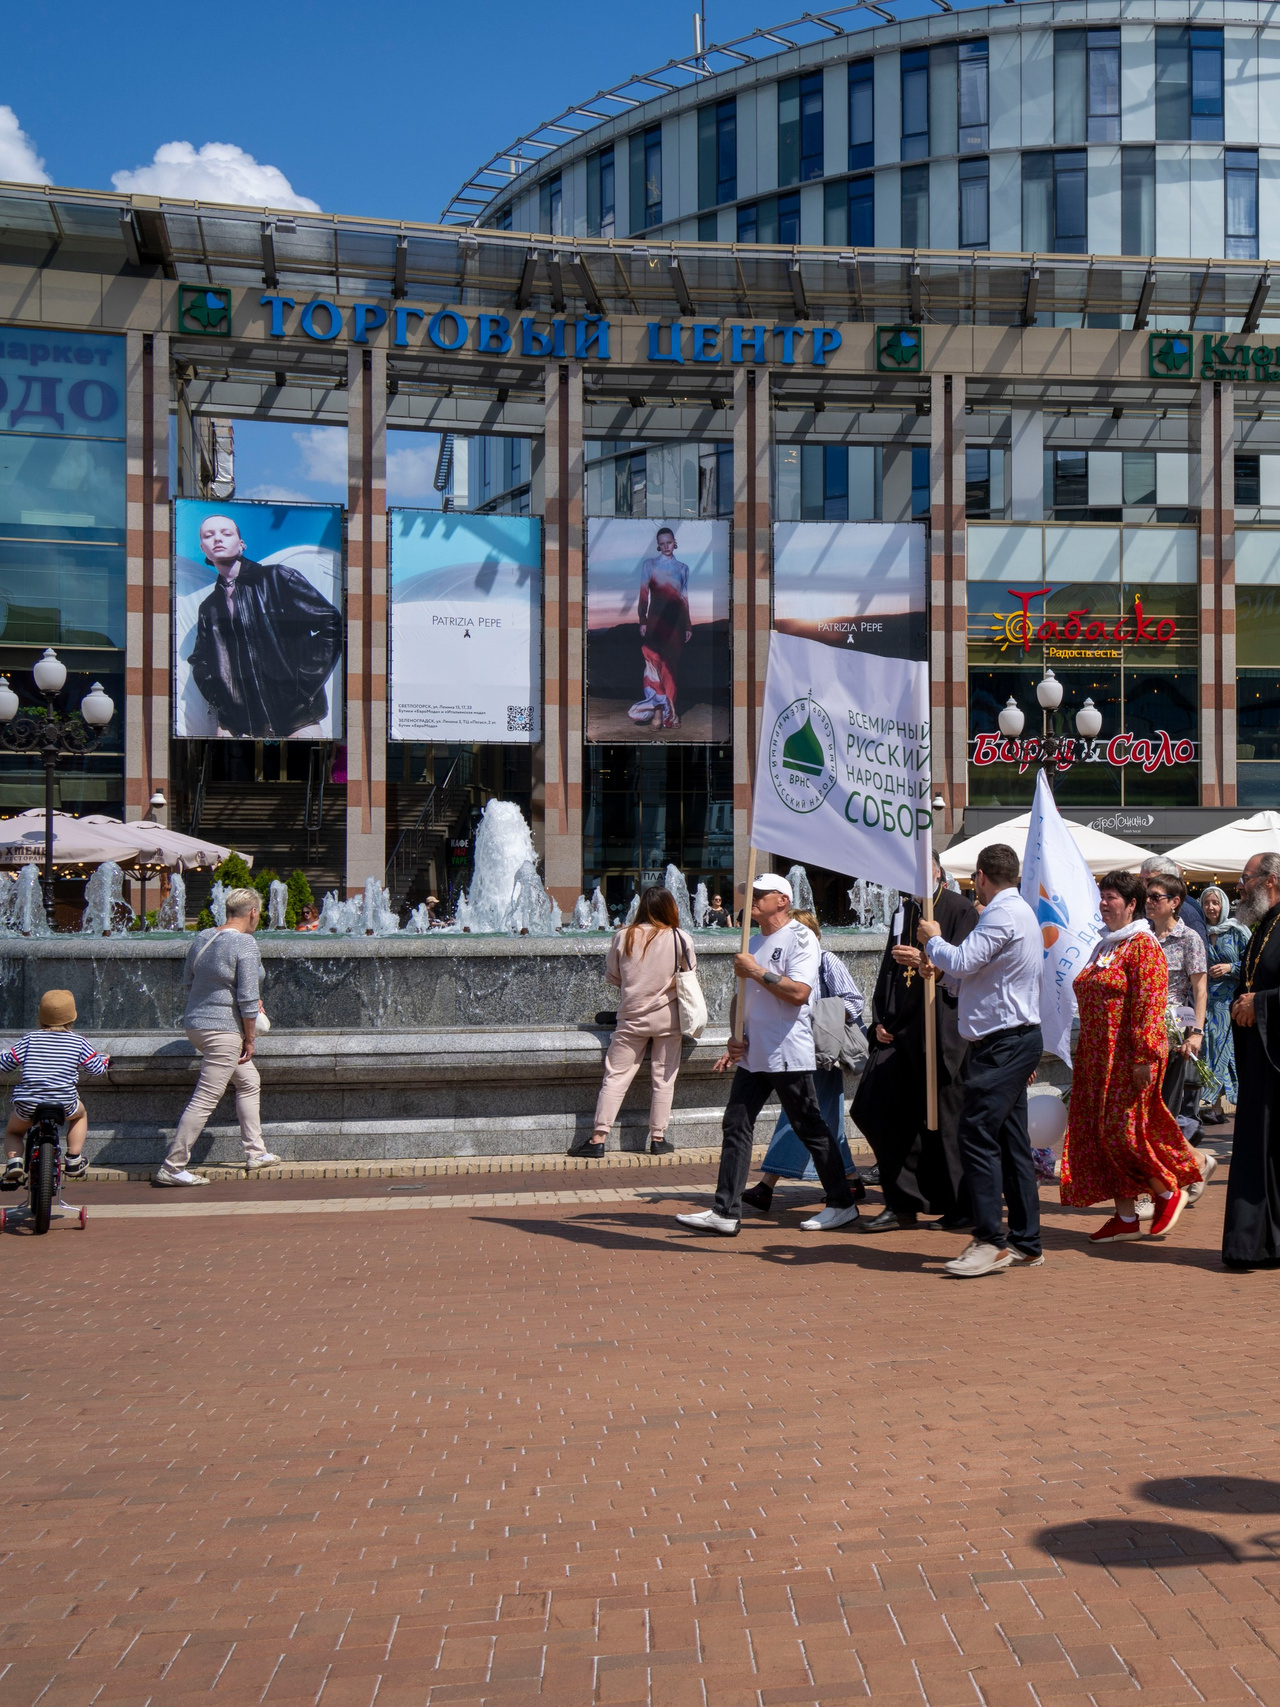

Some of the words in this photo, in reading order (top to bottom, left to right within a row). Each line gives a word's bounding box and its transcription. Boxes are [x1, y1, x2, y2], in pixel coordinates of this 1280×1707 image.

[260, 296, 611, 359] ТОРГОВЫЙ
[647, 322, 842, 365] ЦЕНТР
[0, 341, 112, 366] аркет
[1201, 364, 1249, 381] Сити
[0, 374, 119, 430] ДО
[432, 615, 475, 626] PATRIZIA
[479, 617, 502, 628] PEPE
[818, 622, 857, 632] PATRIZIA
[860, 622, 883, 632] PEPE
[1007, 588, 1176, 652] Табаско
[1050, 647, 1092, 658] Радость
[1094, 649, 1118, 658] есть
[848, 709, 930, 741] ВСЕМИРНЫЙ
[847, 733, 931, 772] РУССКИЙ
[1107, 730, 1195, 773] Сало
[789, 774, 810, 788] ВРНС
[846, 764, 931, 800] НАРОДНЫЙ
[844, 791, 933, 840] СОБОР
